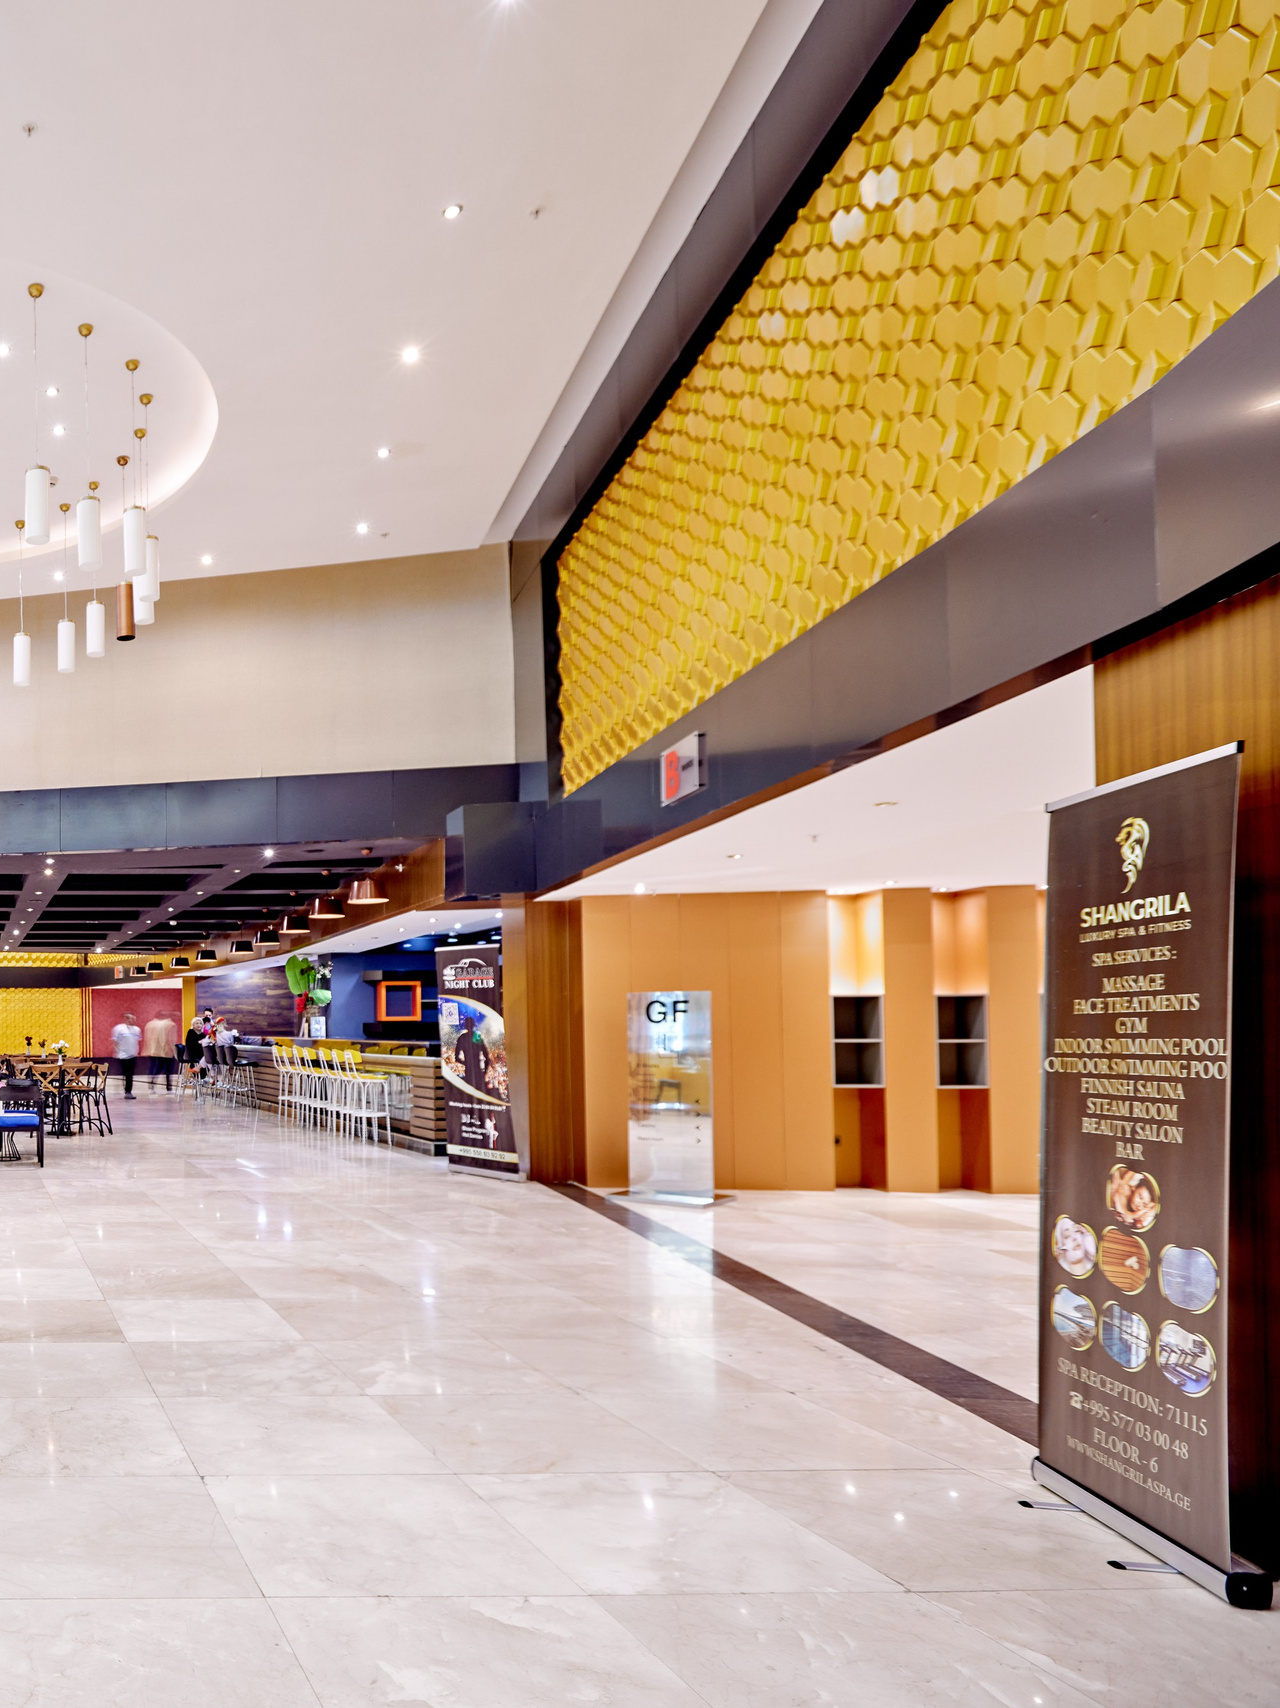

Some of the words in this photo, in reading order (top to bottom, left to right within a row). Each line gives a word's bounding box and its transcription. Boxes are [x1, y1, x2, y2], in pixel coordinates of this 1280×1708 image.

[665, 750, 680, 800] B
[1080, 892, 1192, 928] SHANGRILA
[1079, 929, 1117, 943] LUXURY
[1117, 927, 1136, 938] SPA
[1138, 925, 1147, 936] &
[1148, 919, 1192, 934] FITNESS
[1091, 952, 1113, 967] SPA
[444, 979, 470, 989] NIGHT
[471, 979, 495, 989] CLUB
[1101, 974, 1166, 993] MASSAGE
[646, 1000, 690, 1024] GF
[1073, 998, 1106, 1014] FACE
[1106, 993, 1200, 1013] TREATMENTS
[1115, 1017, 1148, 1033] GYM
[1054, 1038, 1104, 1053] INDOOR
[1104, 1038, 1180, 1055] SWIMMING
[1181, 1038, 1229, 1056] POOL
[1044, 1057, 1110, 1074] OUTDOOR
[1111, 1058, 1188, 1077] SWIMMING
[1189, 1060, 1230, 1079] POO
[1080, 1078, 1135, 1096] FINNISH
[1136, 1080, 1186, 1099] SAUNA
[1086, 1098, 1131, 1117] STEAM
[1132, 1102, 1178, 1121] ROOM
[1081, 1117, 1134, 1137] BEAUTY
[1135, 1122, 1184, 1144] SALON
[1115, 1141, 1145, 1160] BAR
[1057, 1357, 1079, 1381] SPA
[1080, 1365, 1164, 1417] RECEPTION:
[1166, 1403, 1208, 1437] 71115
[1081, 1399, 1110, 1422] +995
[1111, 1410, 1135, 1433] 577
[1135, 1421, 1152, 1442] 03
[1153, 1430, 1170, 1450] 00
[1172, 1439, 1189, 1460] 48
[1093, 1427, 1141, 1465] FLOOR
[1149, 1457, 1159, 1473] 6
